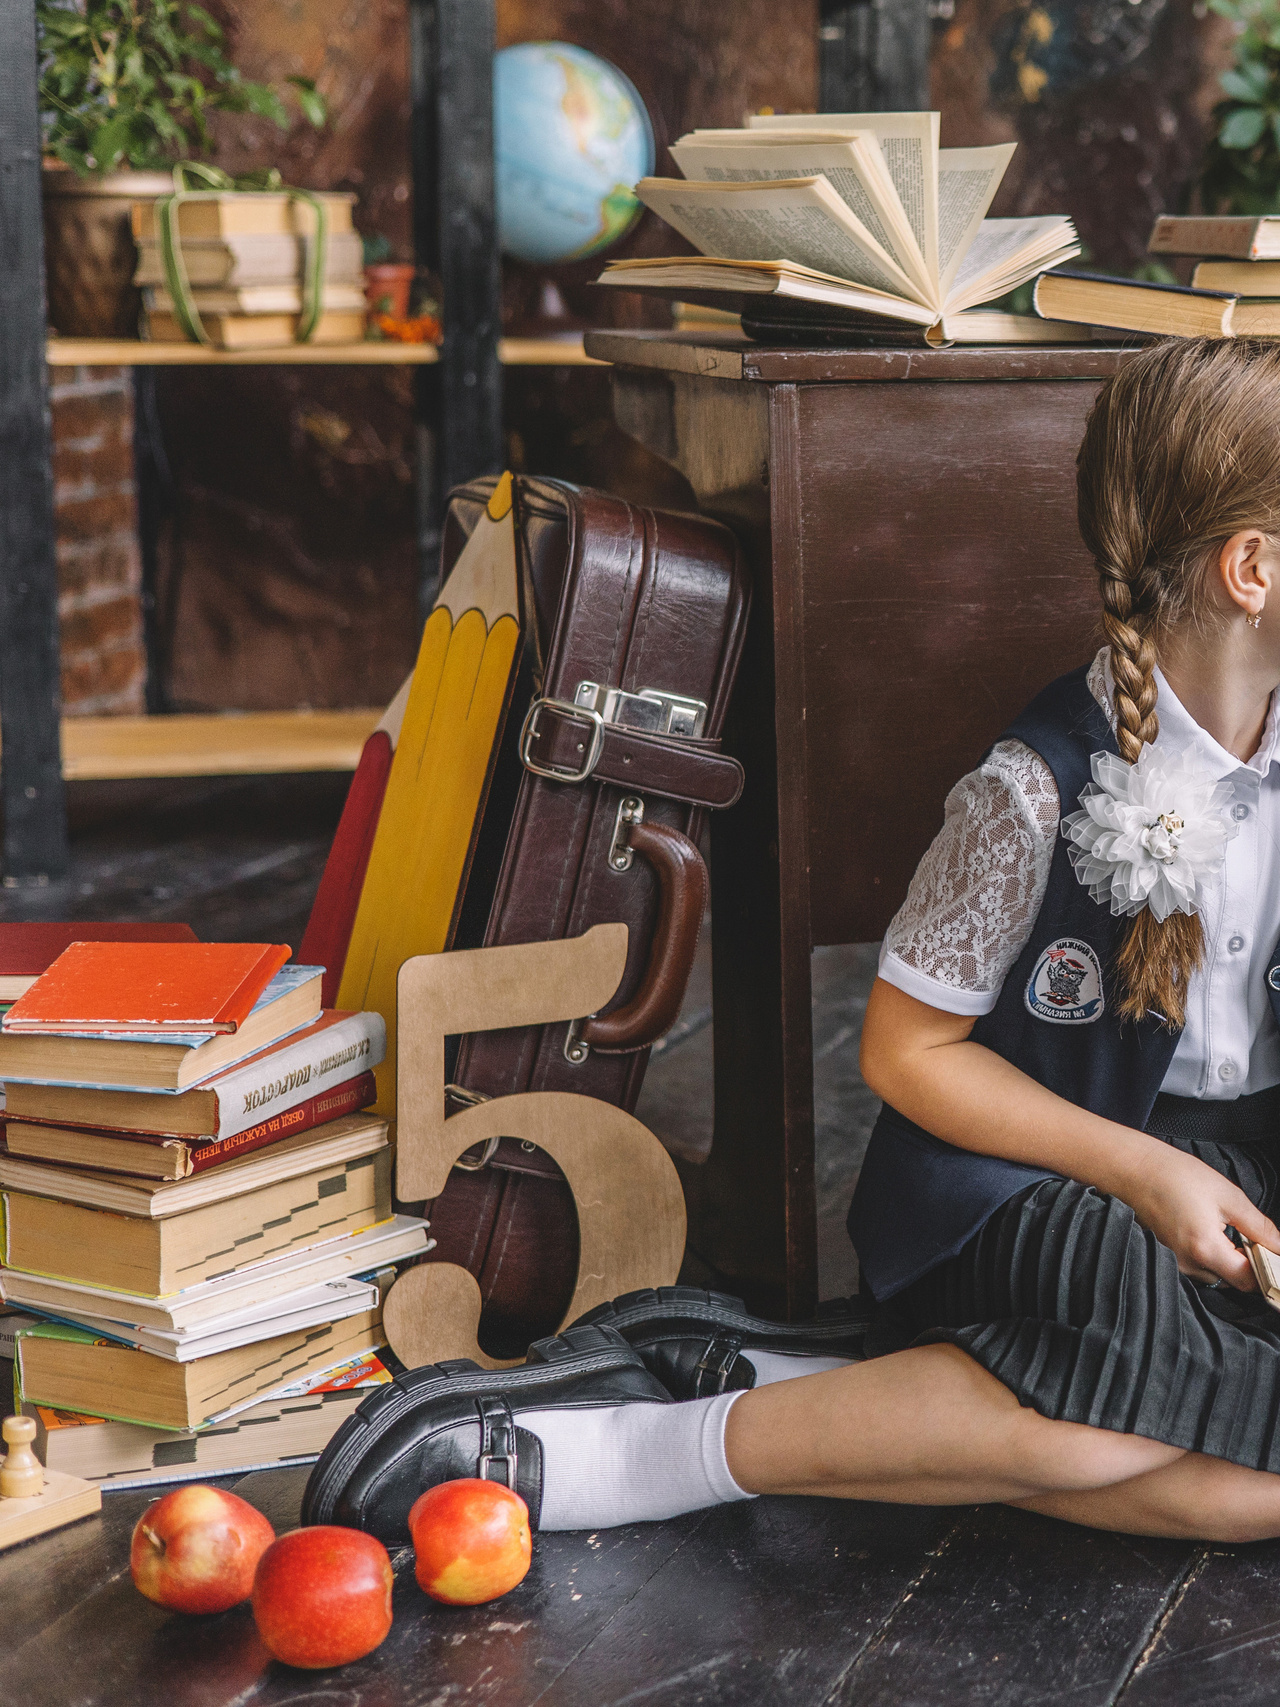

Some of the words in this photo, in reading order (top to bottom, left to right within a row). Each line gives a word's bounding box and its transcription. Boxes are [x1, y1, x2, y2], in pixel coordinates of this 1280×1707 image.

[243, 1064, 312, 1115] ПОДРОСТОК
[268, 1122, 281, 1132] НА
[280, 1109, 305, 1128] ОБЕД
[223, 1125, 267, 1151] КАЖДЫЙ
[195, 1143, 222, 1161] ДЕНЬ
